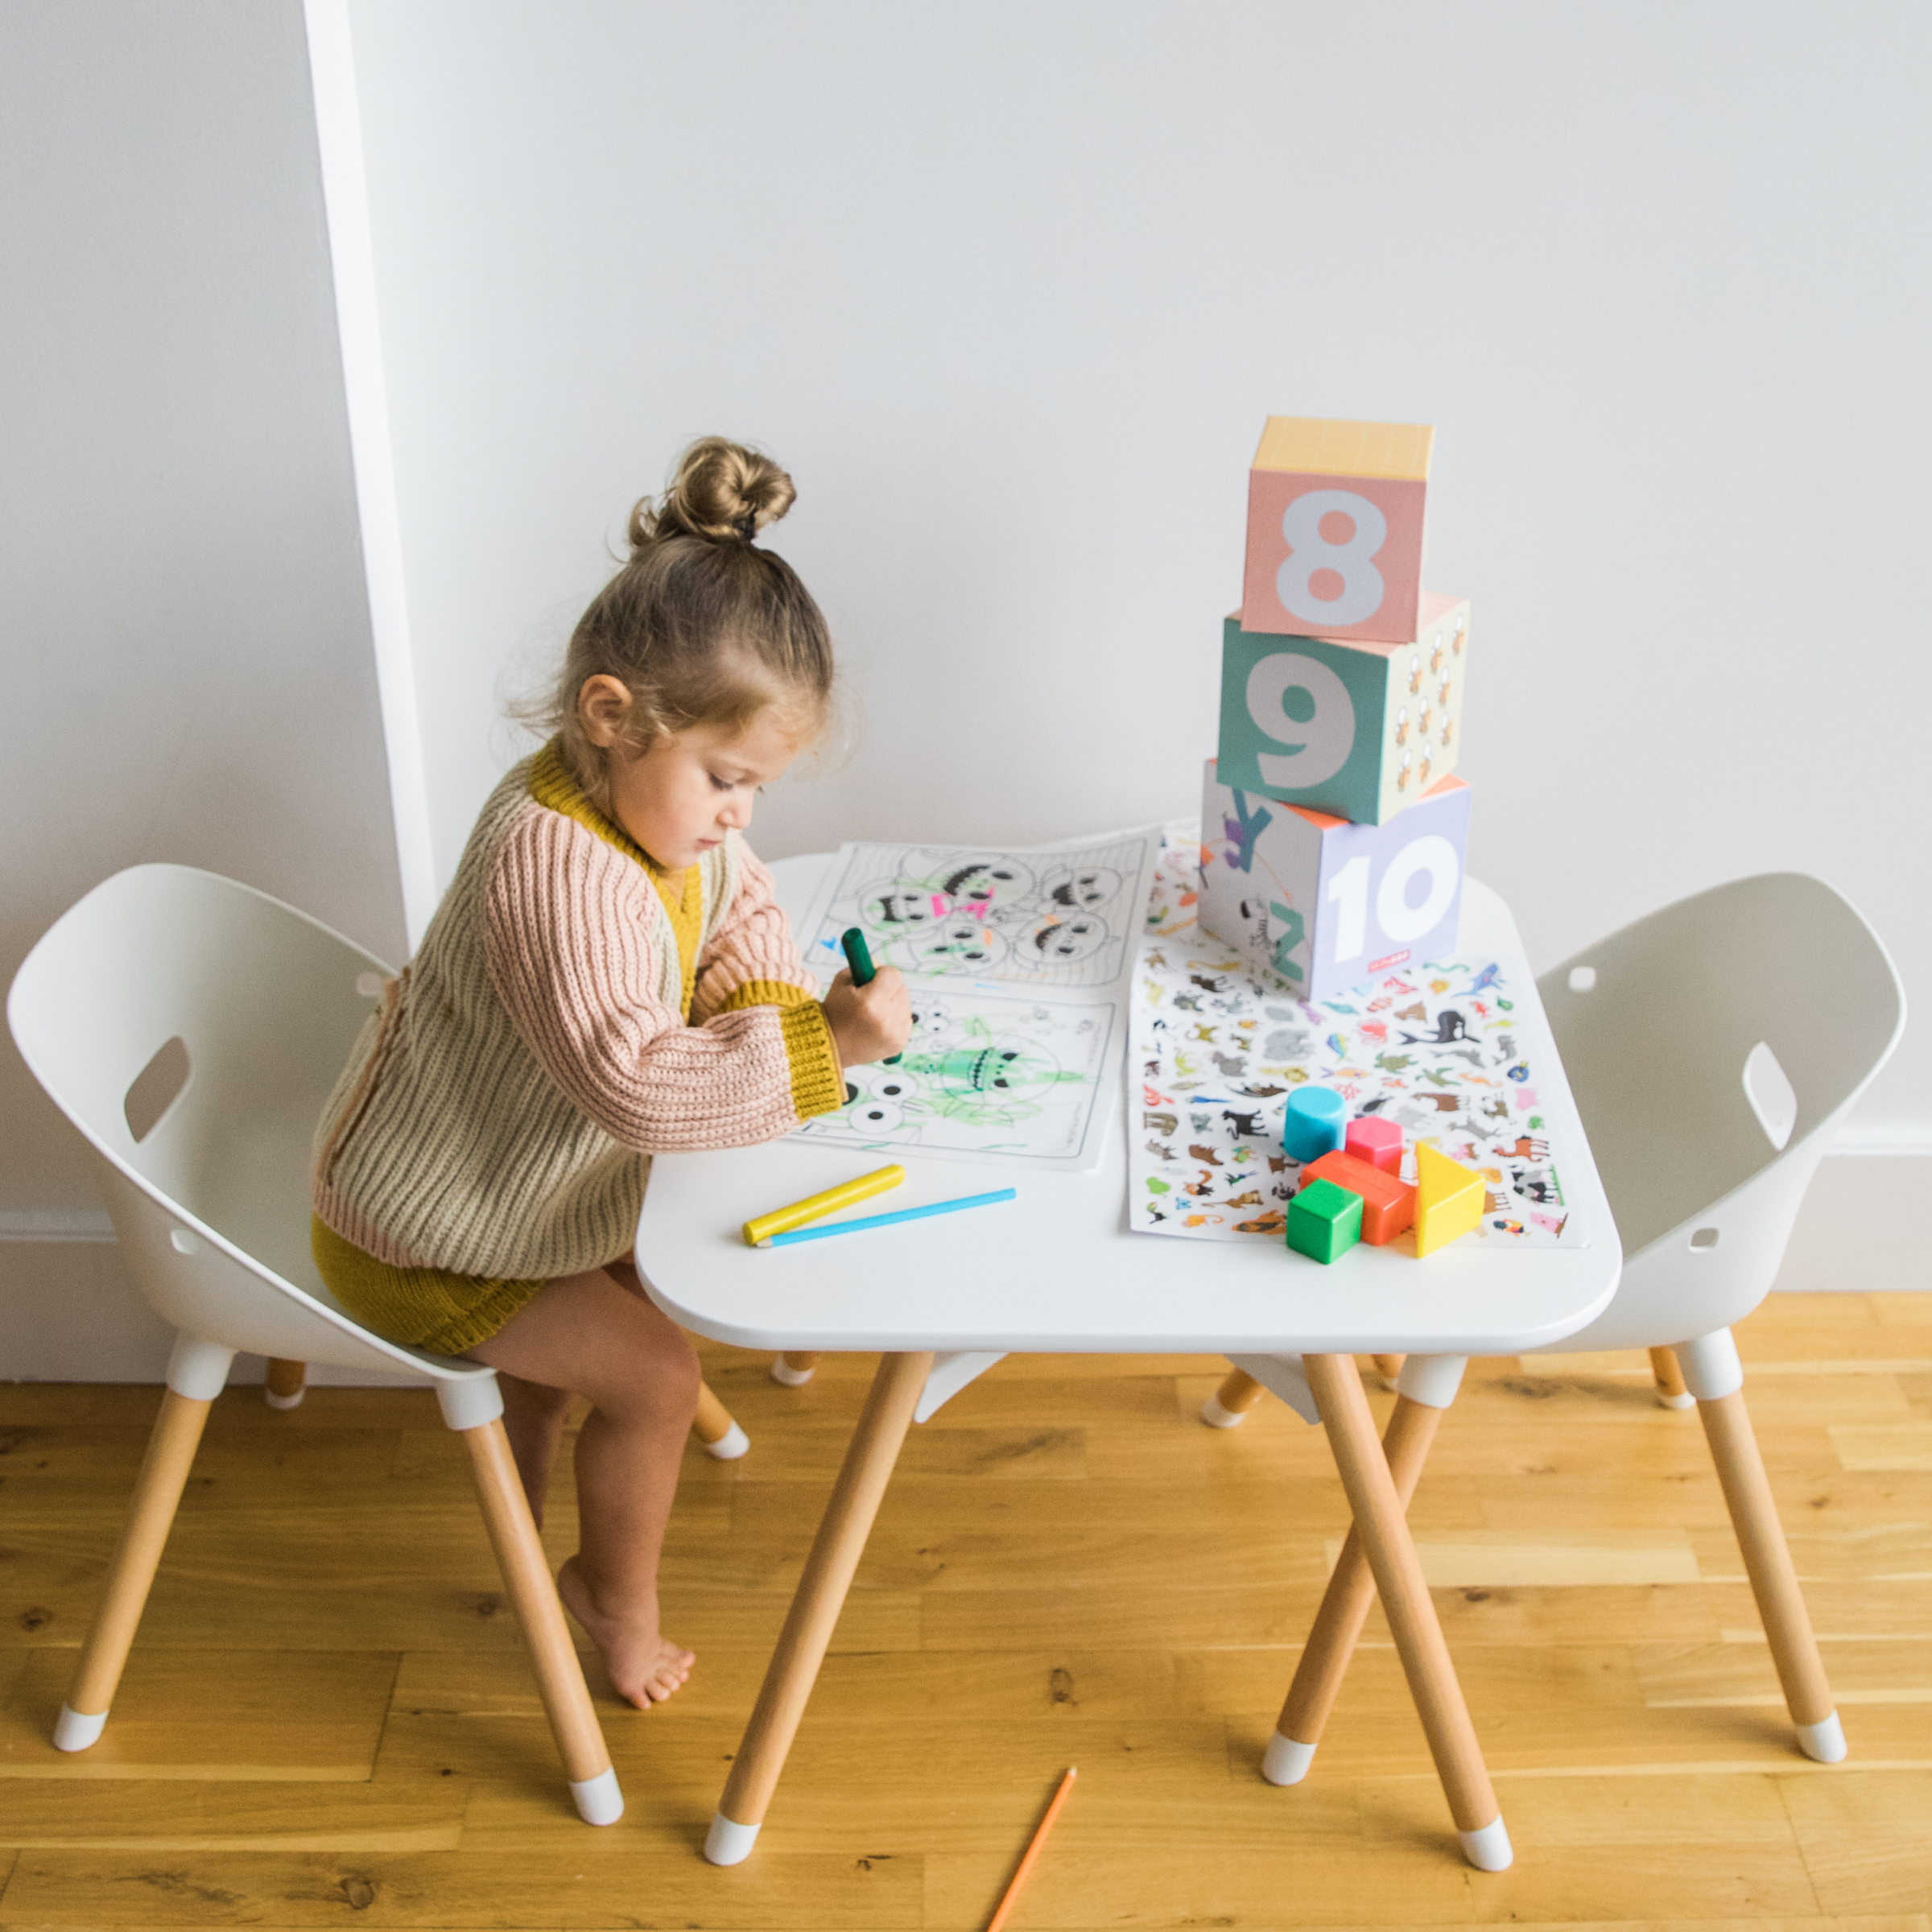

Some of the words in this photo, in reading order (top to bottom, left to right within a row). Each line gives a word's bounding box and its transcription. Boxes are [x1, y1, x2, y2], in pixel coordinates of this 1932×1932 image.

[1276, 489, 1387, 625] 8
[1246, 653, 1356, 789] 9
[1327, 834, 1459, 964] 10
